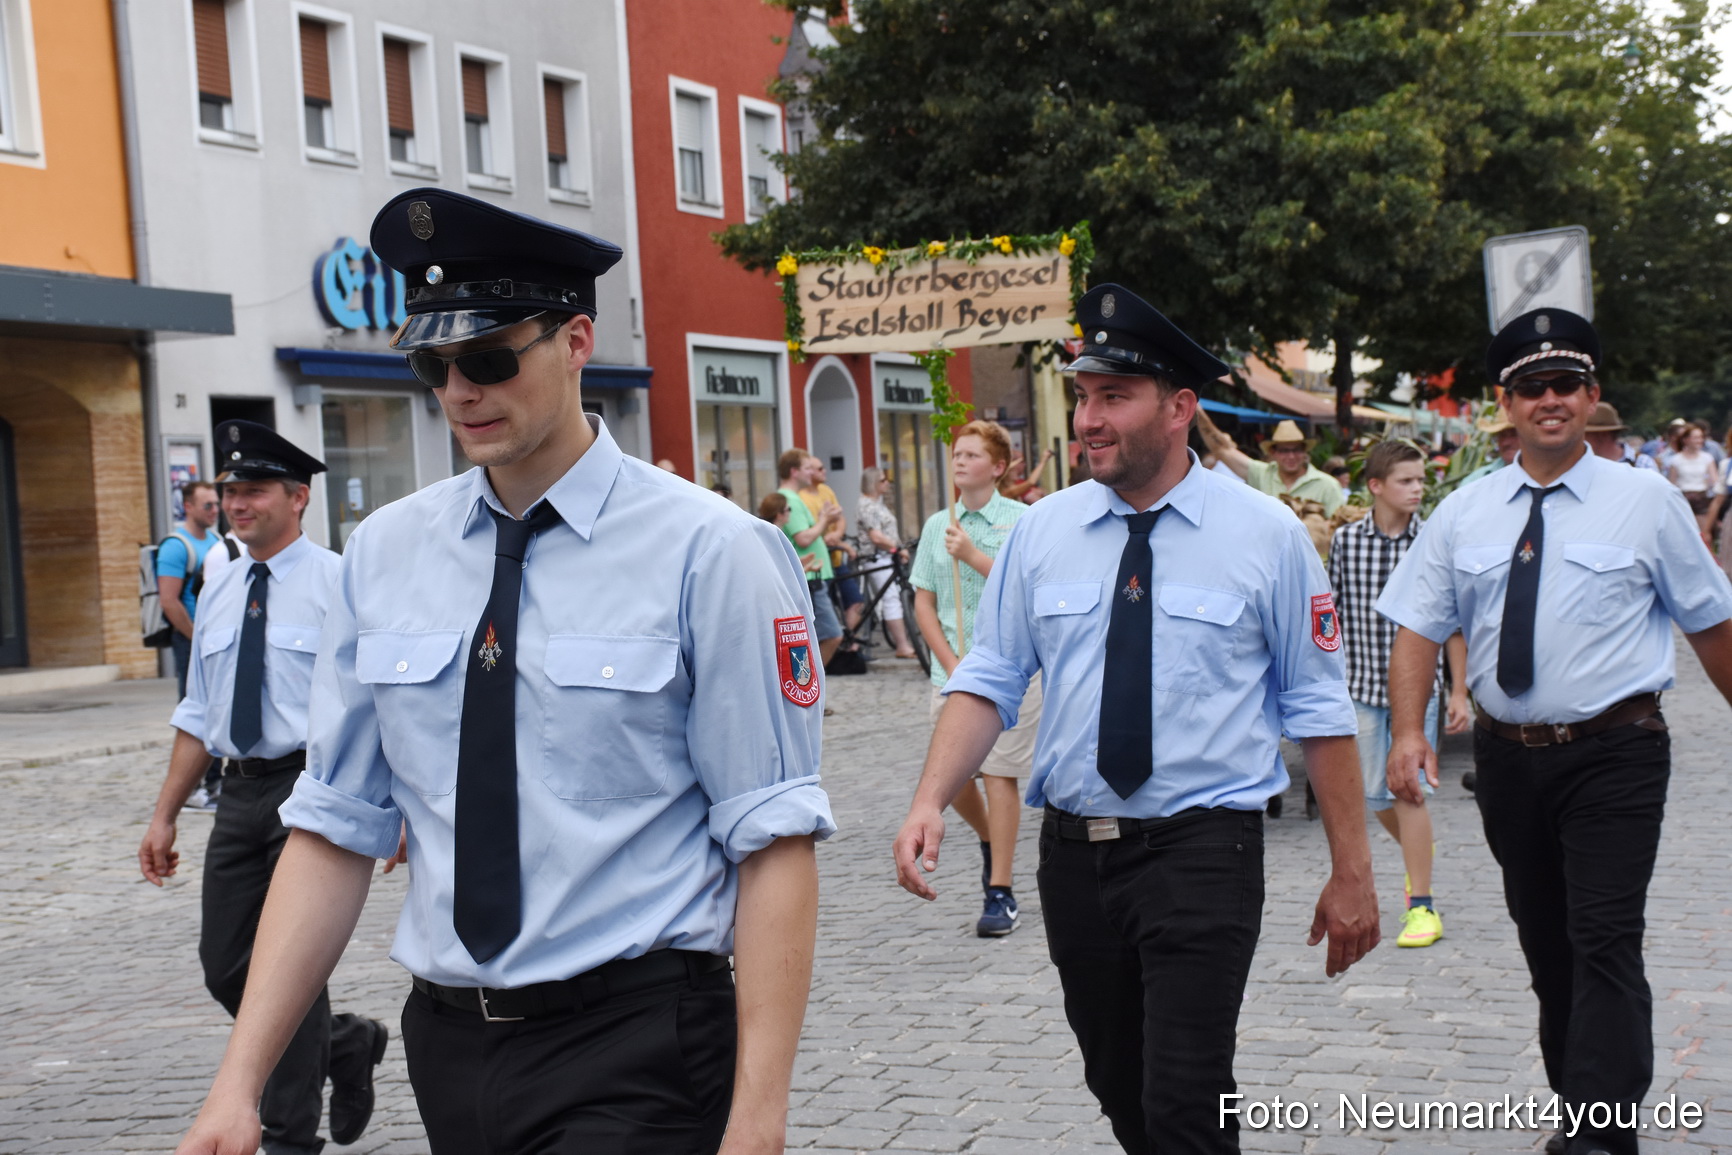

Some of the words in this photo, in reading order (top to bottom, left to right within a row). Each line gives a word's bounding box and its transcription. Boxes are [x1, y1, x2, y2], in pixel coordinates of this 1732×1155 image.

[807, 256, 1060, 306] Stauferbergesel
[809, 301, 944, 346] Eselstall
[942, 298, 1047, 340] Beyer
